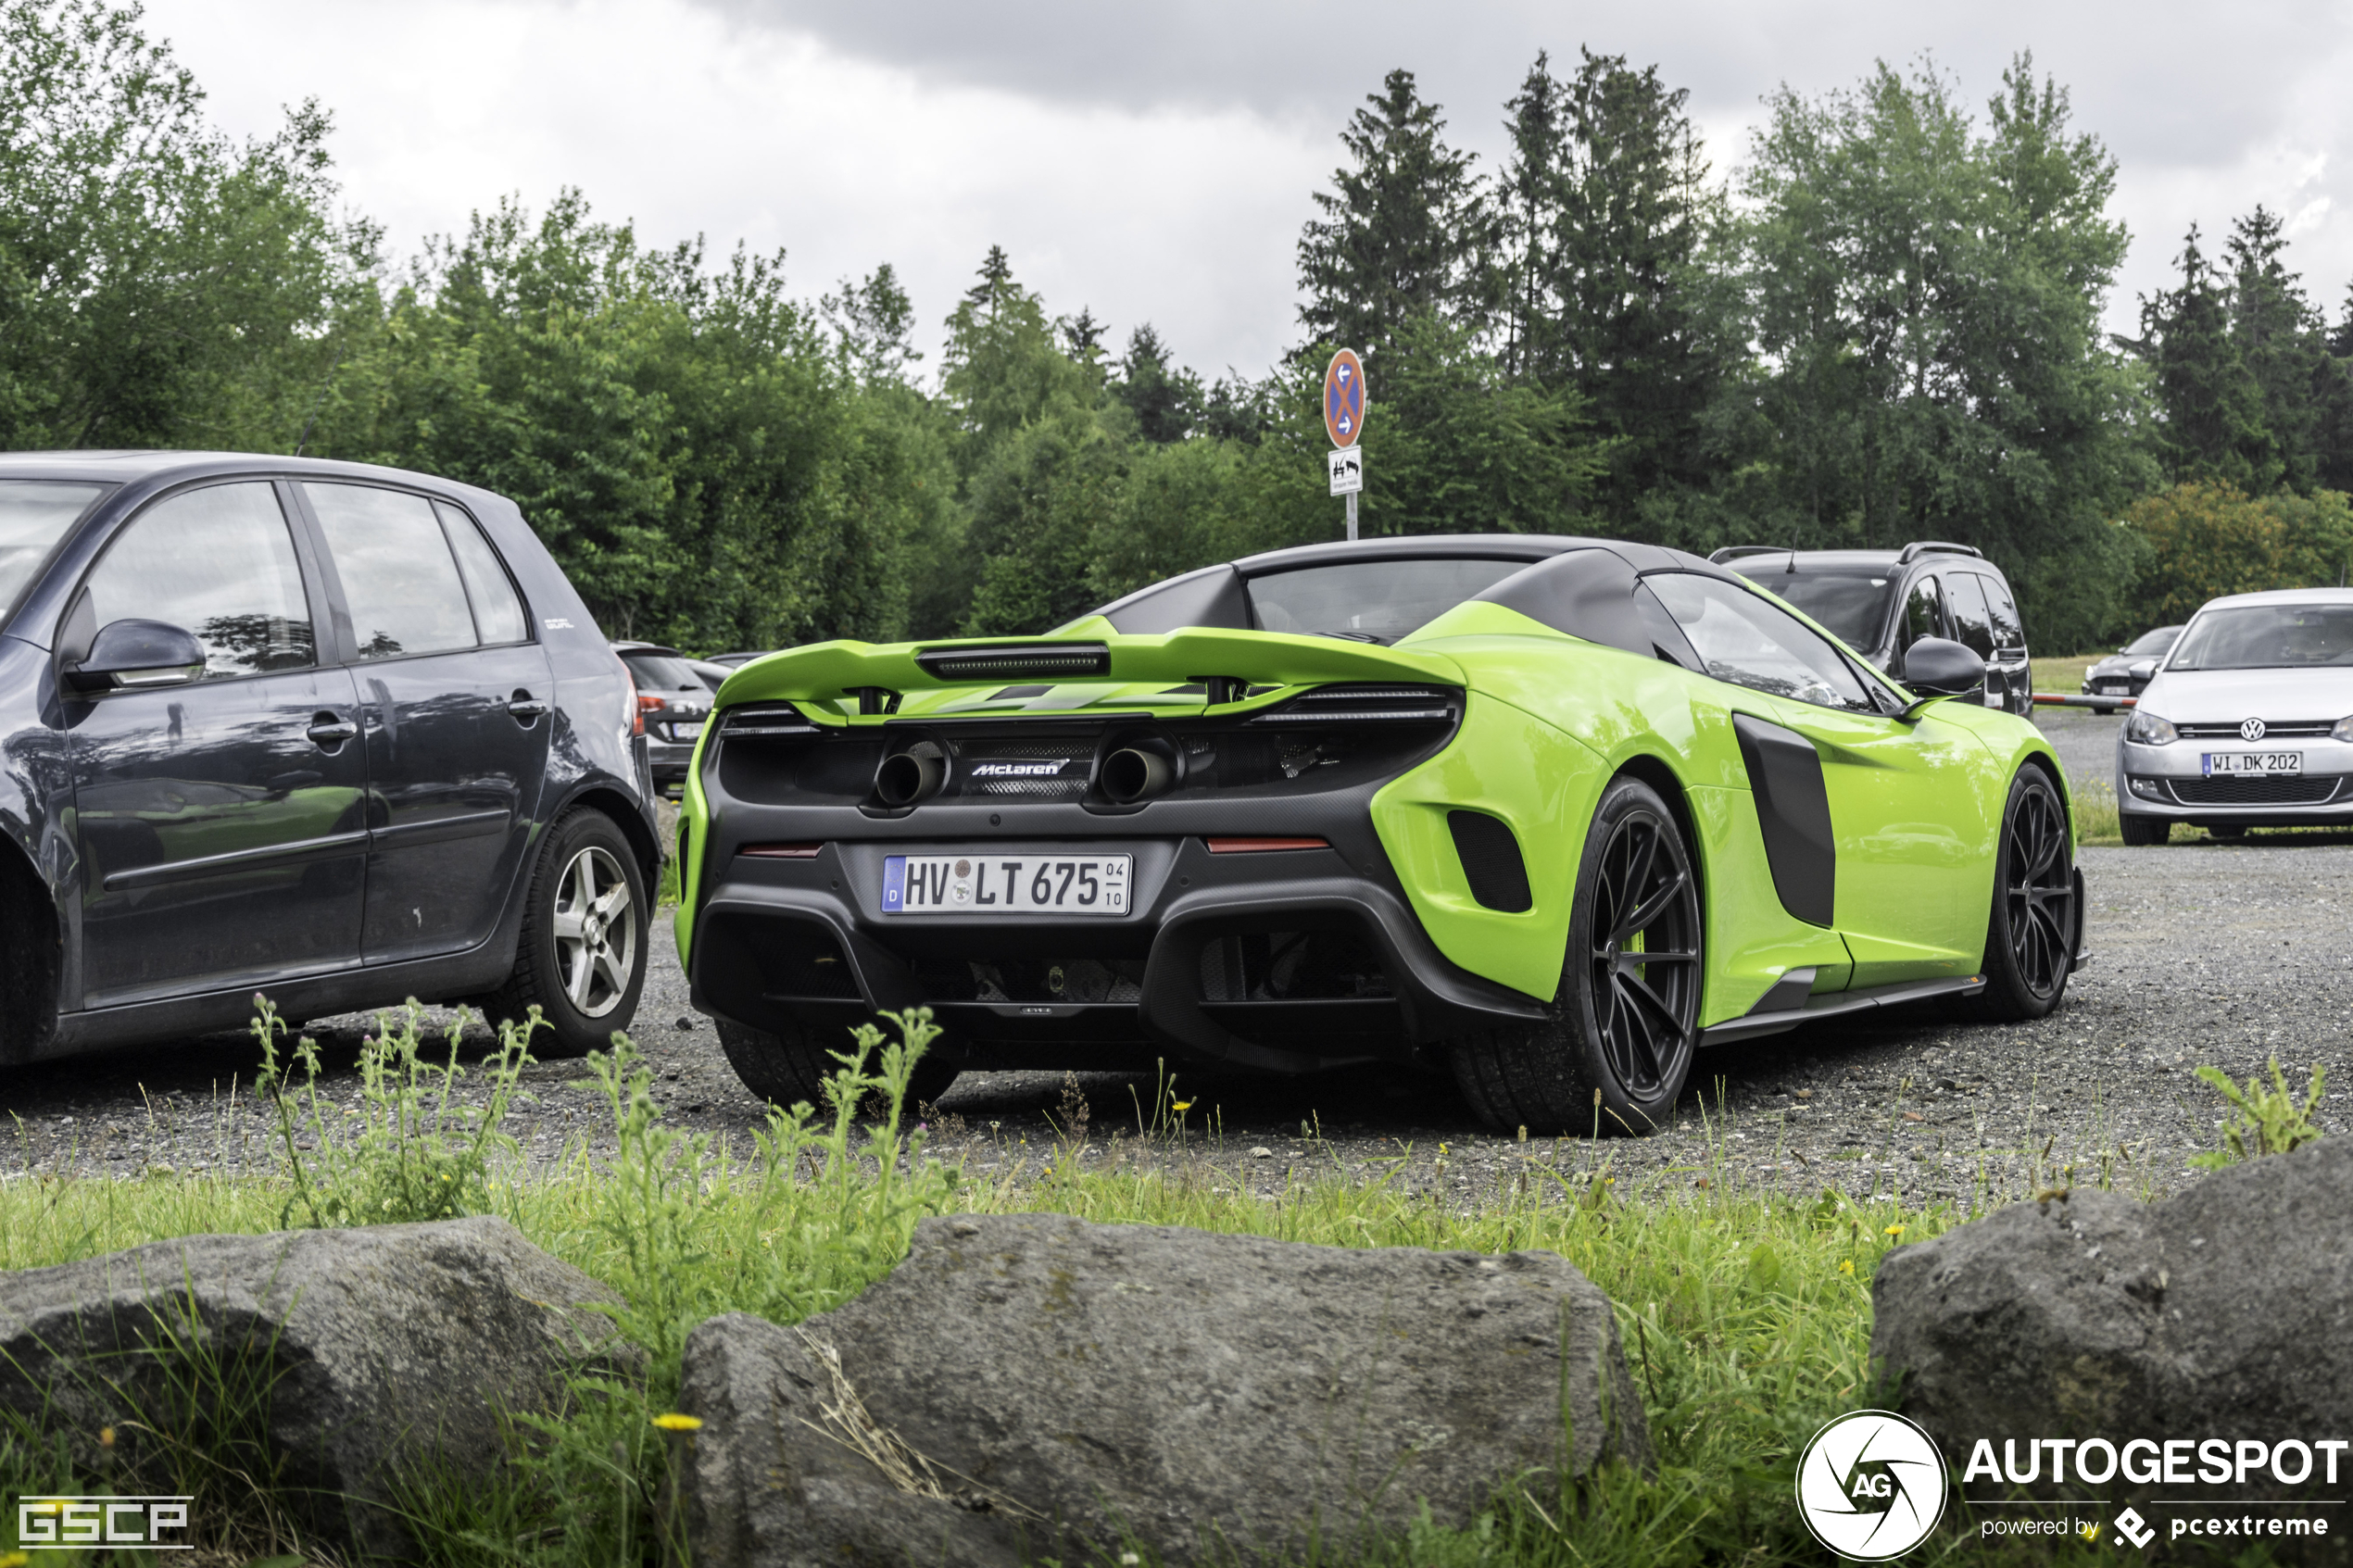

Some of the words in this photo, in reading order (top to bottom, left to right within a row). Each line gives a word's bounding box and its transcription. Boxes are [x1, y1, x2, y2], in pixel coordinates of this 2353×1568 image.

[2213, 756, 2232, 771] WI
[2243, 755, 2263, 771] DK
[2268, 754, 2297, 770] 202
[972, 764, 1059, 775] McLaren
[1106, 863, 1124, 876] 04
[905, 862, 950, 905] HV
[975, 862, 1022, 905] LT
[1031, 862, 1099, 905] 675
[889, 890, 897, 902] D
[1106, 893, 1122, 905] 10
